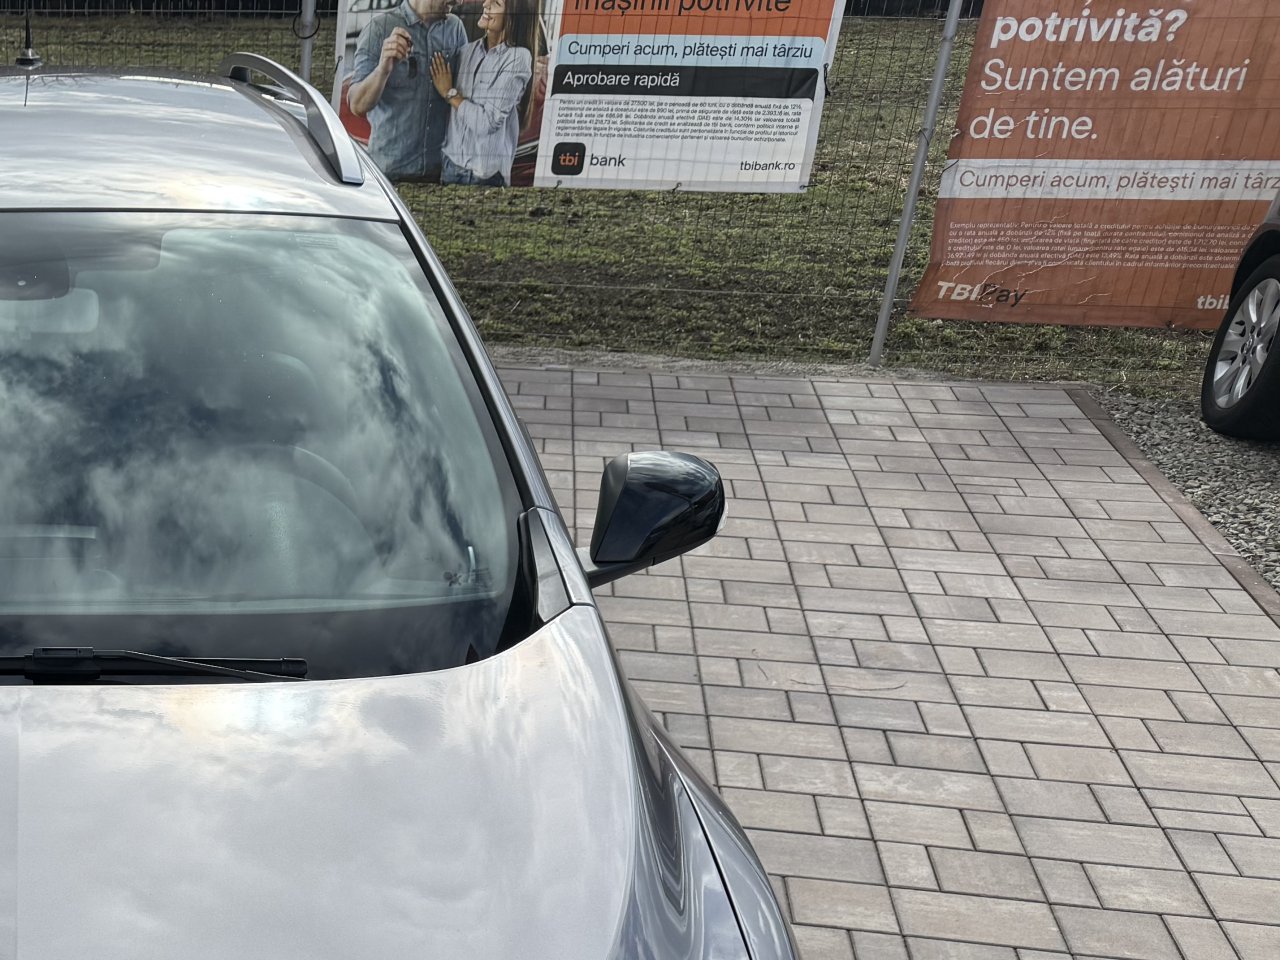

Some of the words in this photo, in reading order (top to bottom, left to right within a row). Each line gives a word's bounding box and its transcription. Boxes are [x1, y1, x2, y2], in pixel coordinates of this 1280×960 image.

[991, 8, 1188, 48] potrivită?
[568, 41, 631, 57] Cumperi
[634, 44, 678, 59] acum,
[682, 41, 736, 60] plătești
[741, 43, 769, 57] mai
[772, 43, 814, 60] târziu
[562, 71, 630, 87] Aprobare
[633, 72, 680, 89] rapidă
[980, 58, 1120, 92] Suntem
[1129, 58, 1251, 92] alături
[970, 108, 1013, 140] de
[1025, 108, 1098, 140] tine.
[558, 152, 579, 167] tbi
[590, 153, 626, 168] bank
[739, 159, 796, 172] tbibank.ro
[959, 170, 1046, 191] Cumperi
[1200, 172, 1239, 190] mai
